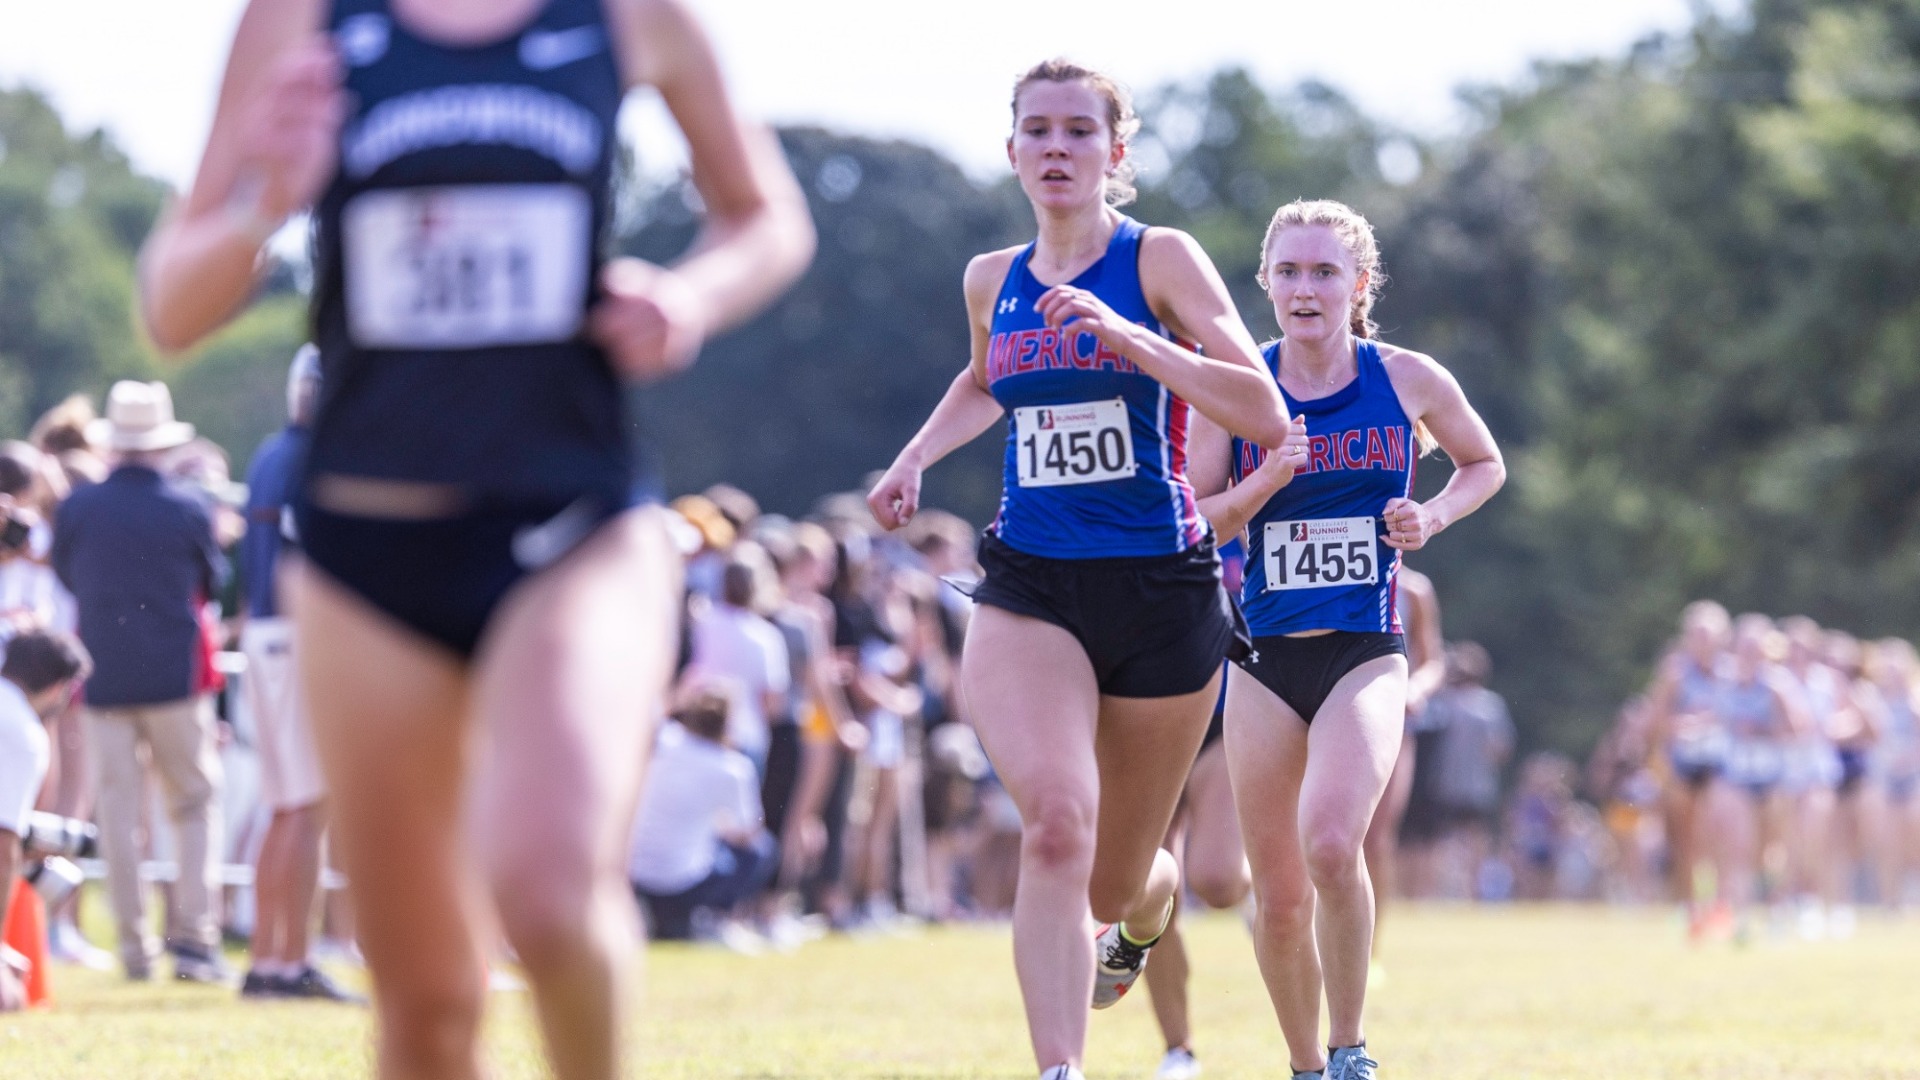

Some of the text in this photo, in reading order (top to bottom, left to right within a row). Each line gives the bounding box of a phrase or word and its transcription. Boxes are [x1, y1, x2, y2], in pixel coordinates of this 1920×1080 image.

[985, 322, 1146, 385] MERICA
[1023, 427, 1126, 478] 1450
[1241, 426, 1406, 480] ARICAN
[1309, 526, 1349, 535] RUNNING
[1271, 541, 1372, 584] 1455
